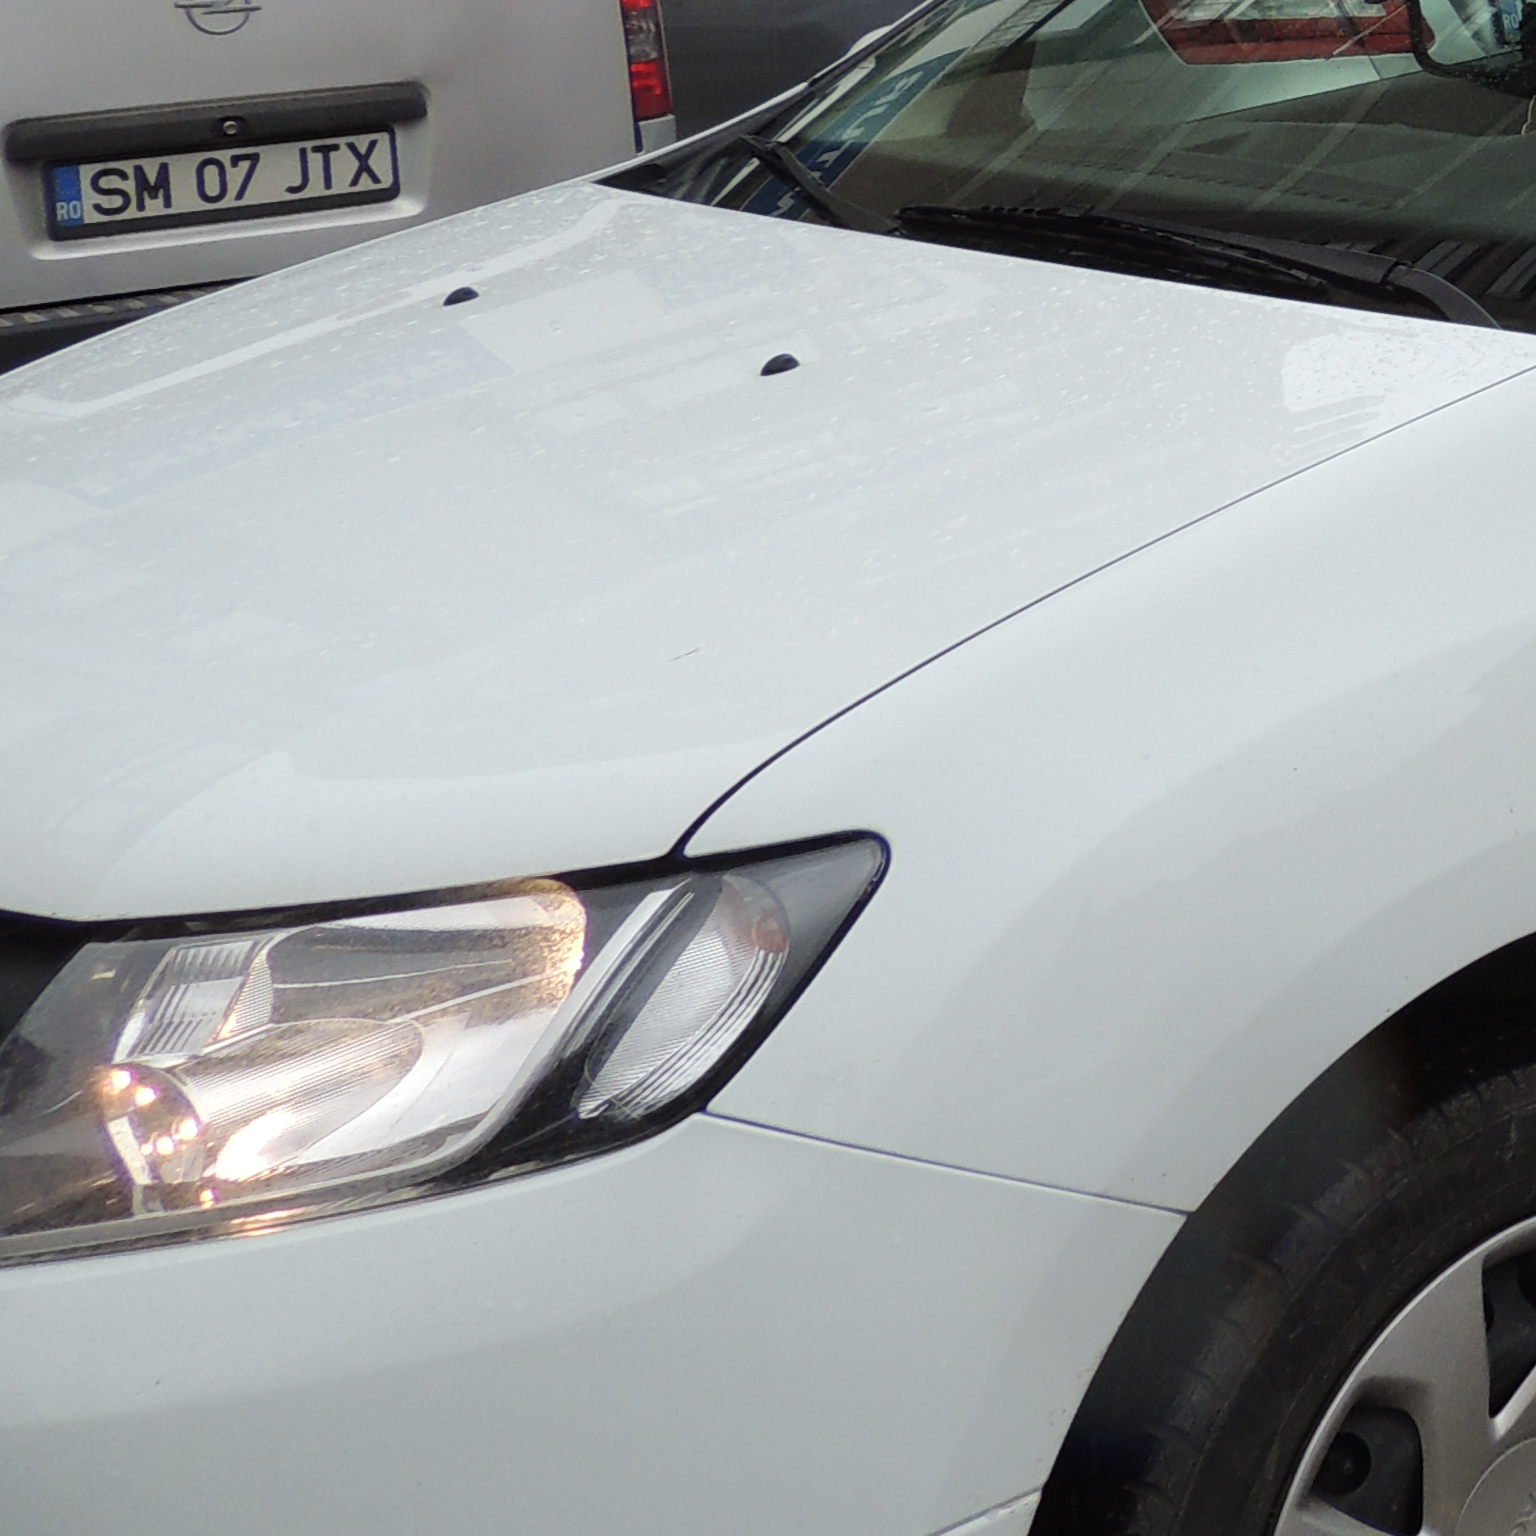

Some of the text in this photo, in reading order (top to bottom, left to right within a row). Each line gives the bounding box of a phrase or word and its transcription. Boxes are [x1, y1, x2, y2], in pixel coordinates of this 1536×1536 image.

[1502, 13, 1520, 30] RO
[90, 138, 383, 217] SM 07 JTX
[56, 200, 82, 222] RO
